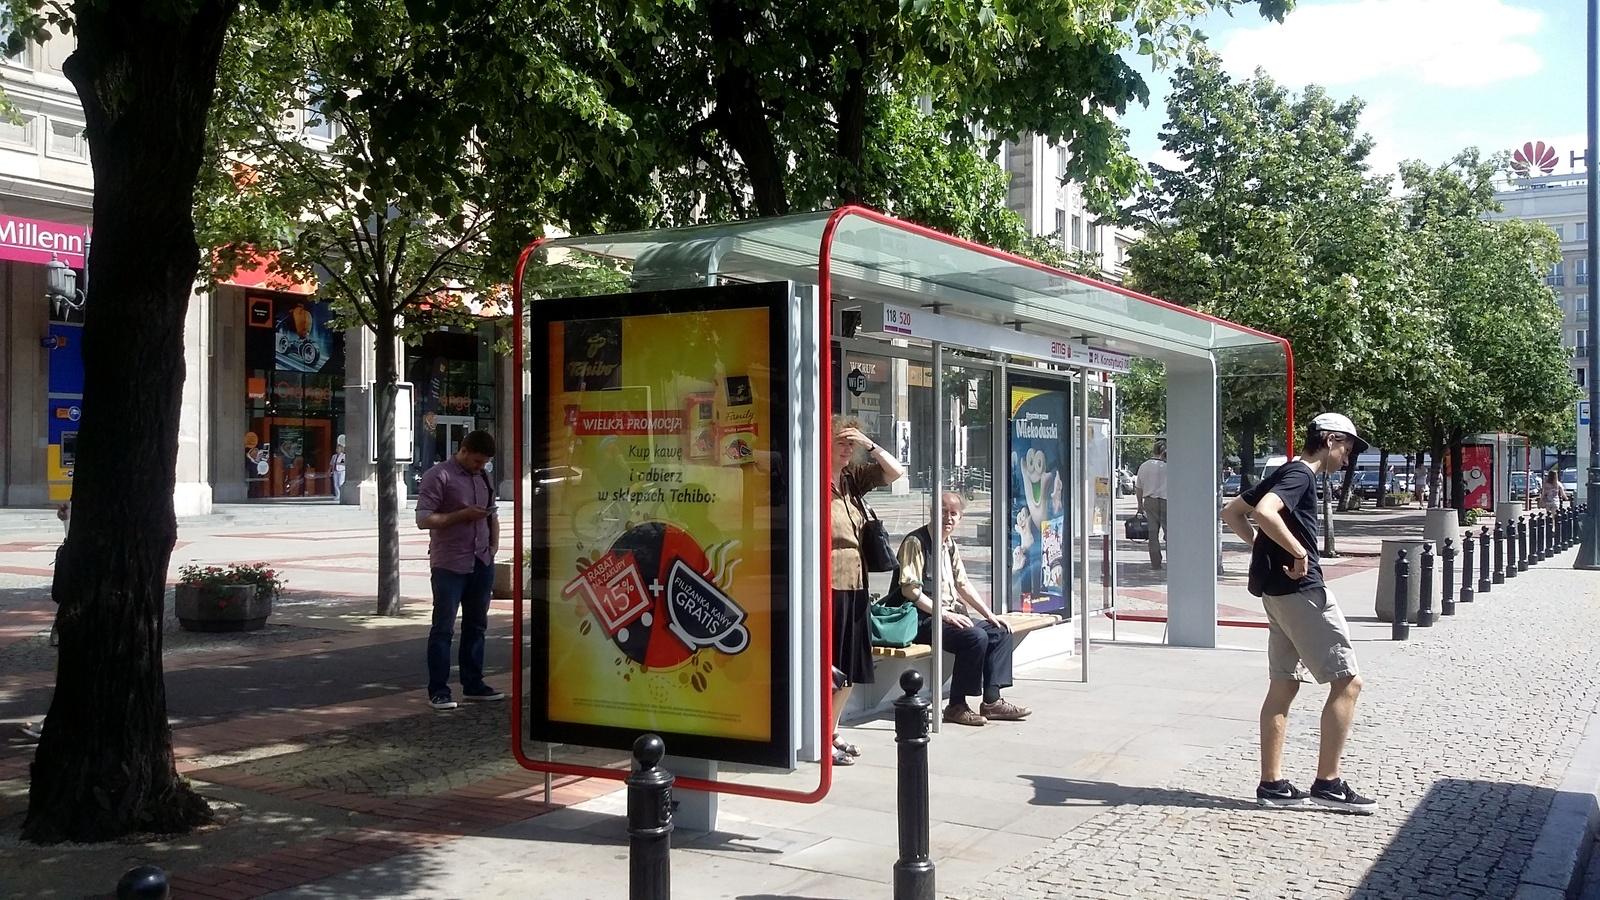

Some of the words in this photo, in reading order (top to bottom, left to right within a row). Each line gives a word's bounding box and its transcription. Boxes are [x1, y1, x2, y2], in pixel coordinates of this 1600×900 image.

[0, 220, 86, 253] Millenn
[886, 309, 897, 323] 118
[899, 311, 911, 326] 520
[1051, 341, 1066, 355] ams
[568, 361, 619, 377] Tchibo
[583, 418, 624, 431] WIELKA
[627, 417, 682, 432] PROMOCJA
[629, 445, 650, 460] Kup
[654, 444, 682, 460] kawę
[630, 468, 634, 482] i
[638, 468, 683, 483] odbierz
[598, 491, 608, 501] w
[613, 487, 664, 504] sklepach
[670, 488, 716, 503] Tchibo:
[587, 556, 615, 581] RABAT
[592, 581, 604, 591] NA
[602, 559, 626, 581] ZAKUPY
[603, 578, 635, 617] 15%
[674, 577, 710, 610] FILIŻANKA
[710, 607, 732, 628] KAWY
[676, 592, 720, 634] GRATIS
